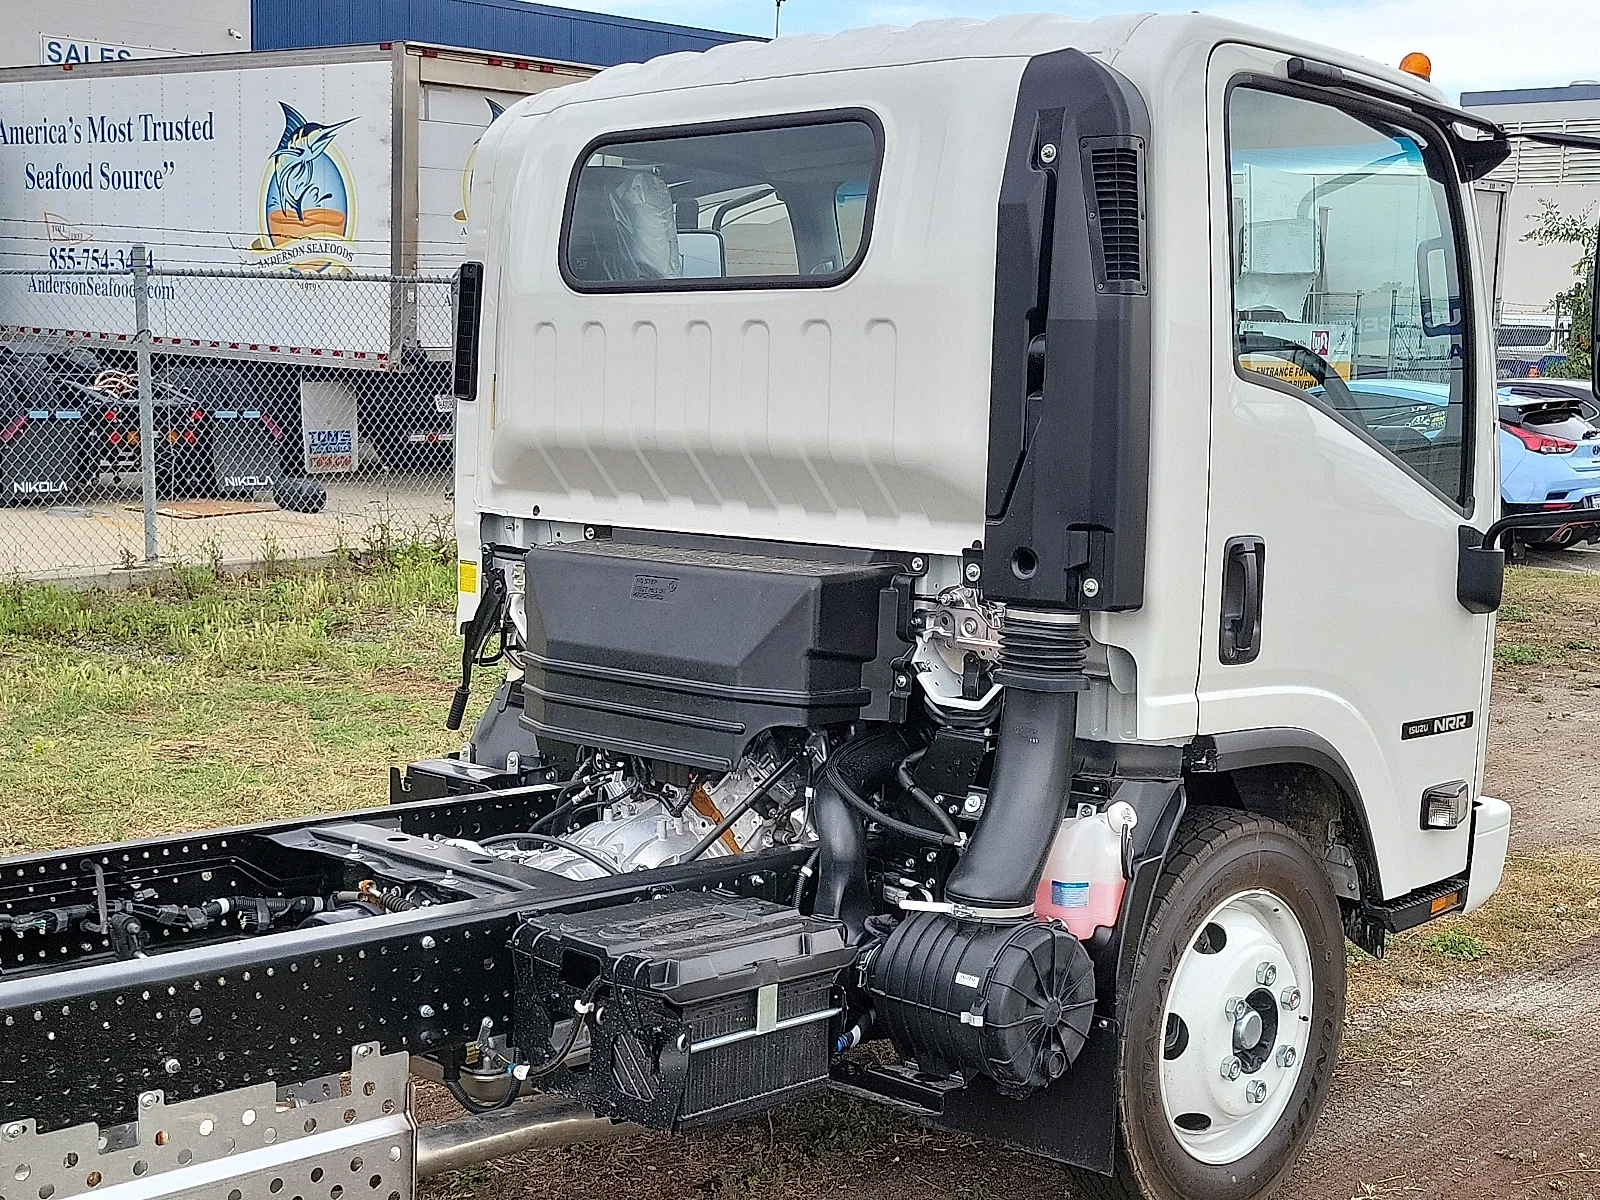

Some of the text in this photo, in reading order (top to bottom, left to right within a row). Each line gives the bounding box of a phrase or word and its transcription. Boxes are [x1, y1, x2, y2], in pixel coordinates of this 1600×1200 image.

[87, 115, 134, 144] Most
[138, 111, 215, 142] Trusted
[25, 161, 175, 191] Seafood Source”
[49, 247, 154, 271] 855-754-344
[258, 242, 355, 269] ANDERSON SEAFOODS
[1256, 366, 1294, 378] ENTRANCE
[14, 481, 68, 494] NIKOLA
[224, 475, 275, 487] NIKOLA
[1408, 714, 1467, 735] ISUZU NRR
